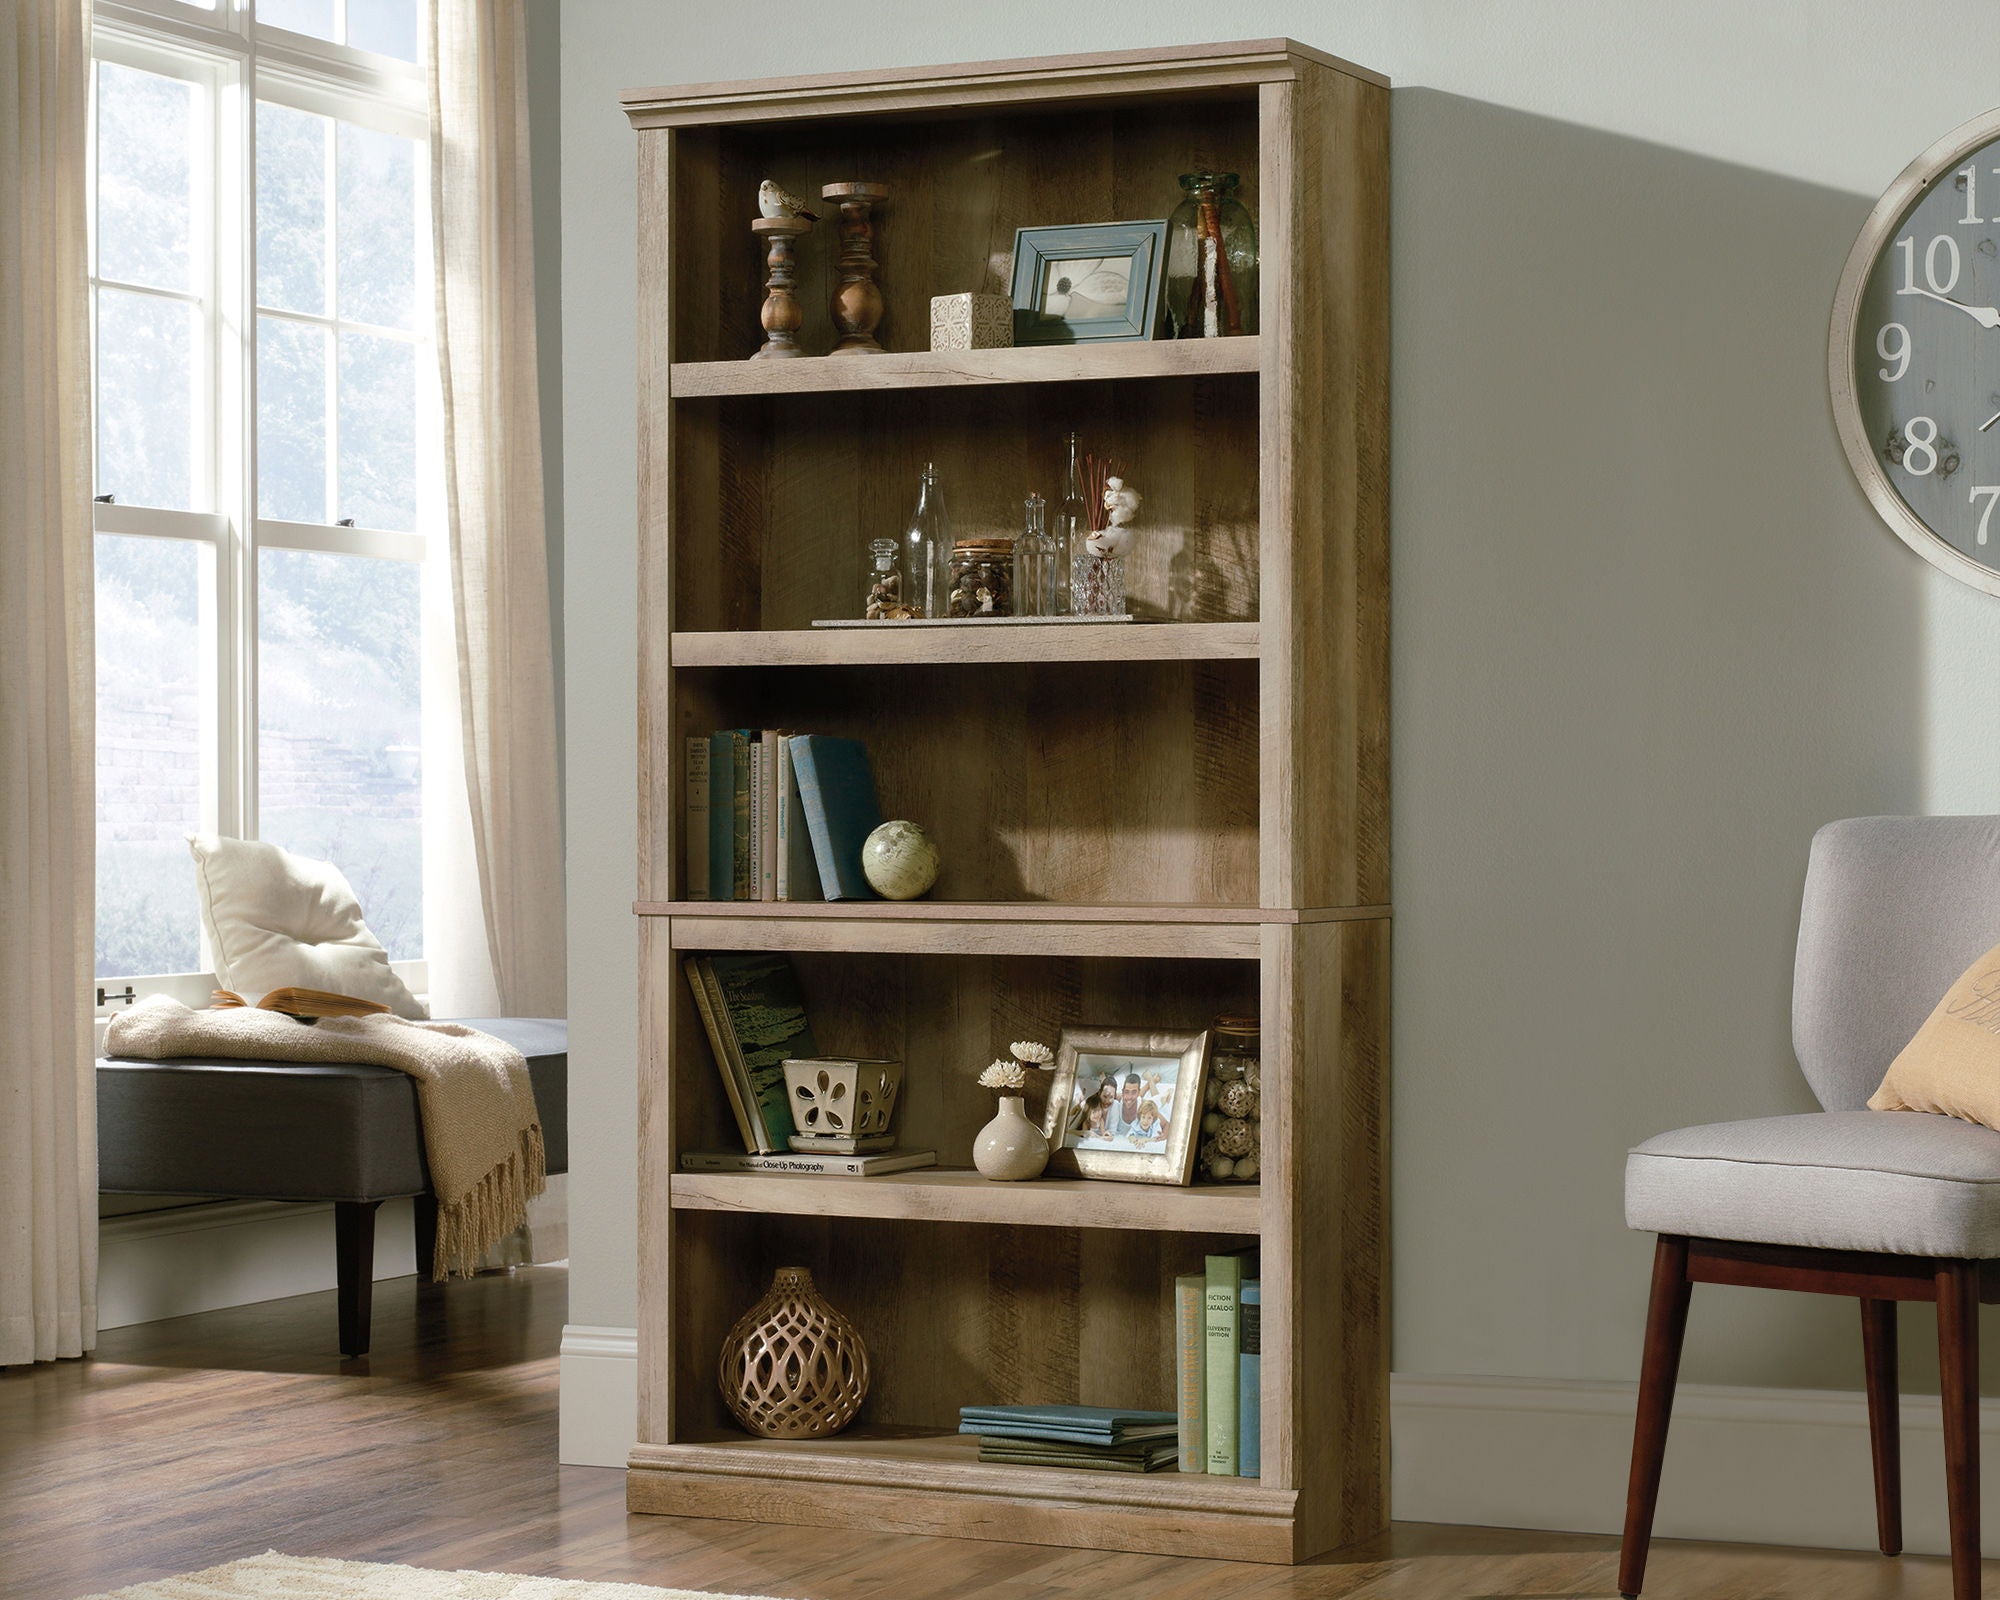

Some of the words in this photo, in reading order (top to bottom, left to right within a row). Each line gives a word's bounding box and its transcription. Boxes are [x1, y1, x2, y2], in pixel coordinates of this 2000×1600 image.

[1896, 234, 1960, 294] 10
[1876, 322, 1912, 382] 9
[1902, 416, 1938, 476] 8
[1968, 485, 2000, 545] 7
[788, 1161, 825, 1173] Photography
[1207, 1304, 1234, 1312] CATALOG
[1208, 1294, 1232, 1302] FICTION
